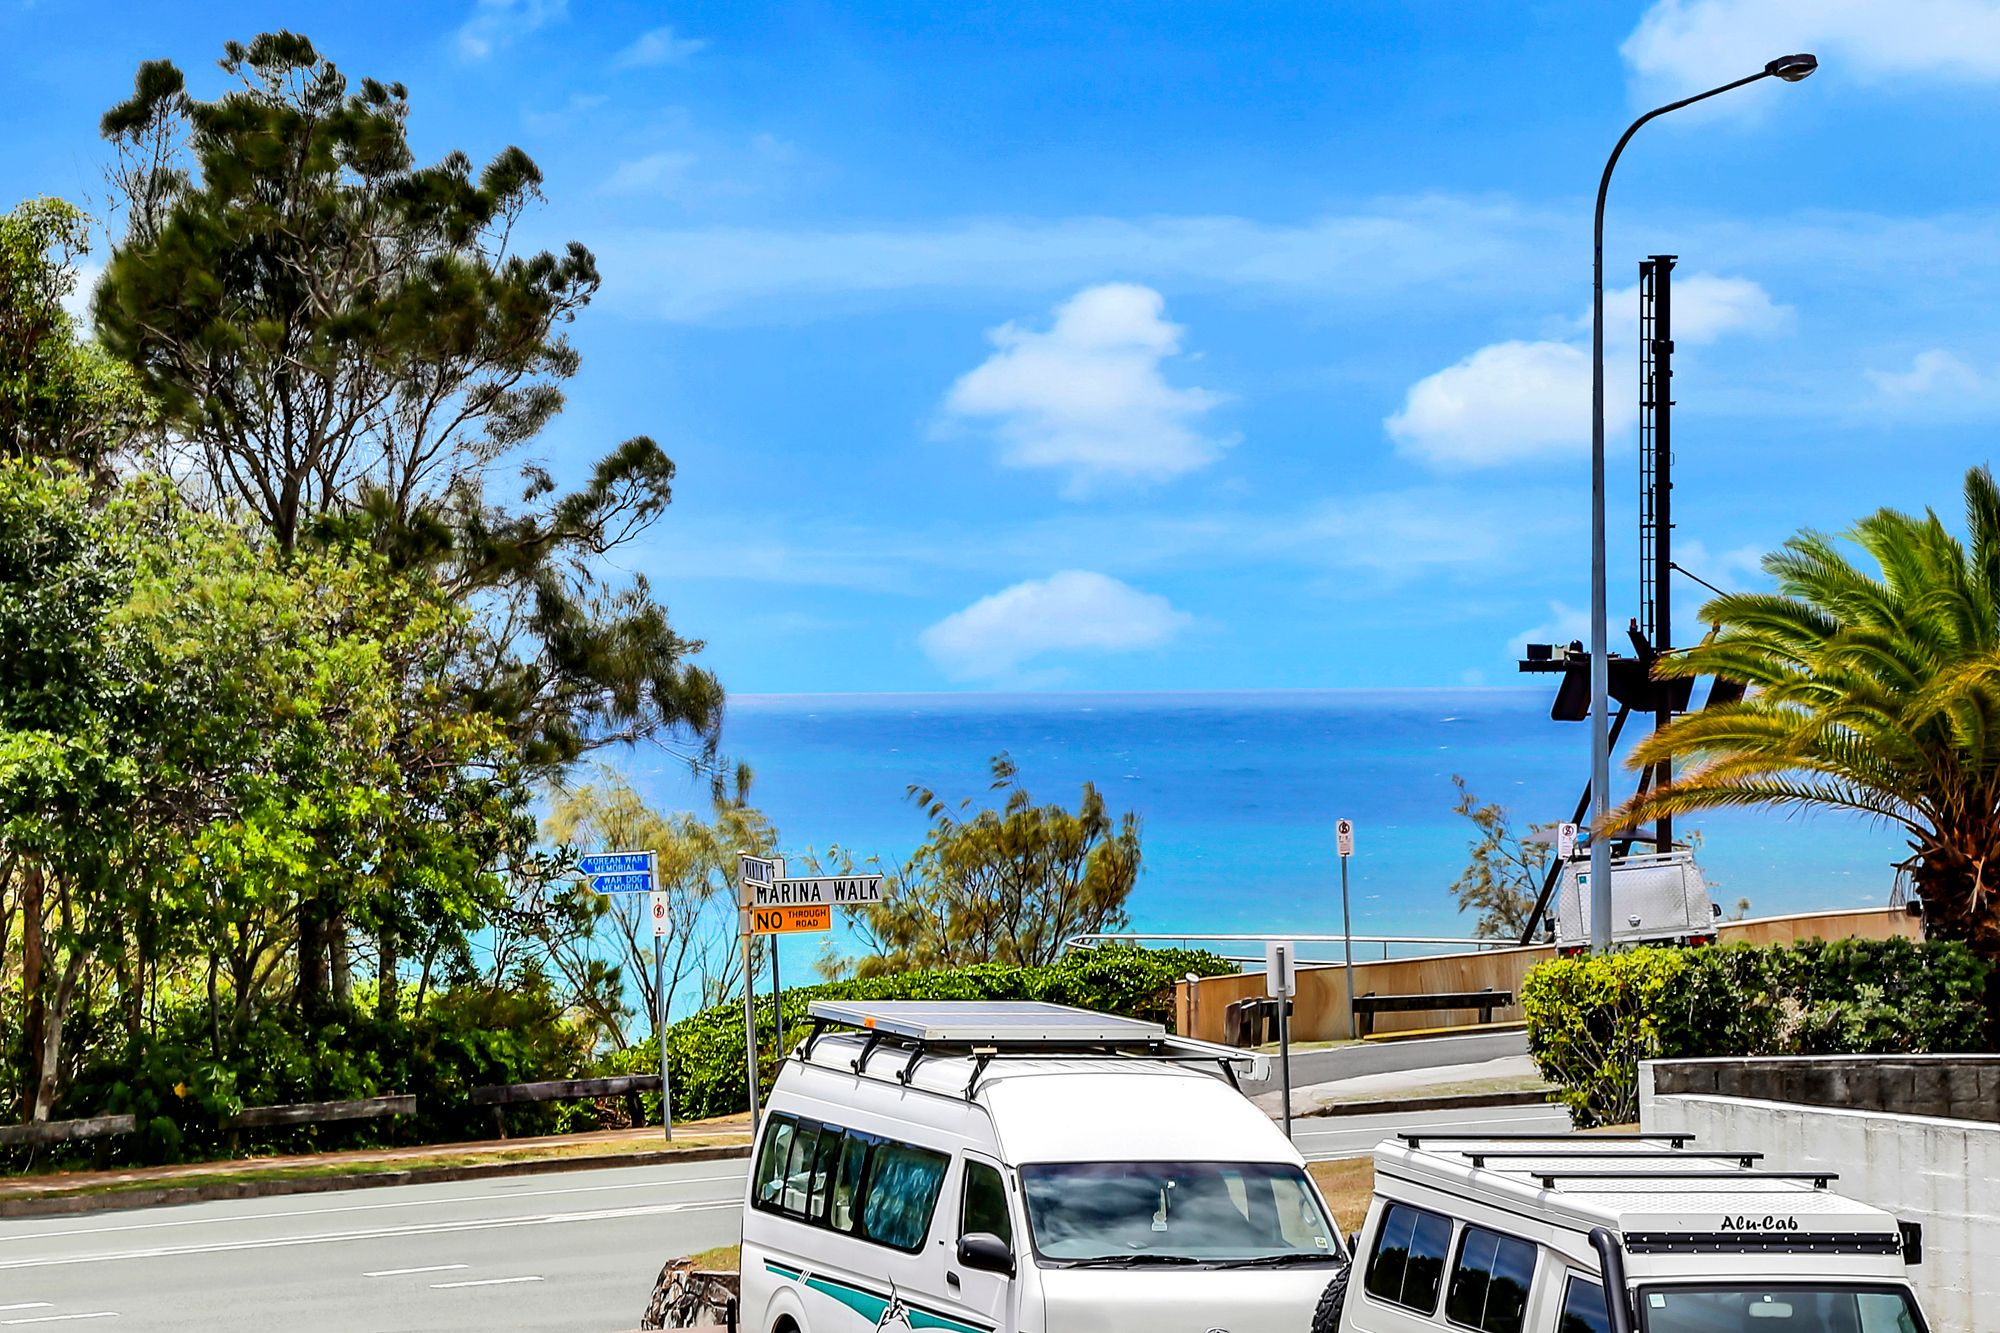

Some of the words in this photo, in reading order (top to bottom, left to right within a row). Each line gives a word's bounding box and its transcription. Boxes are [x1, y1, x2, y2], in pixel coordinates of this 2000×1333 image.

[587, 856, 621, 866] KOREAN
[625, 855, 643, 863] WAR
[594, 863, 635, 873] MEMORIAL
[604, 876, 622, 884] WAR
[626, 875, 643, 884] DOG
[602, 883, 643, 892] MEMORIAL
[756, 881, 822, 904] MARINA
[834, 879, 879, 901] WALK
[756, 911, 783, 930] NO
[788, 908, 826, 919] THROUGH
[795, 919, 819, 928] ROAD
[1720, 1215, 1799, 1231] Alu-Cab
